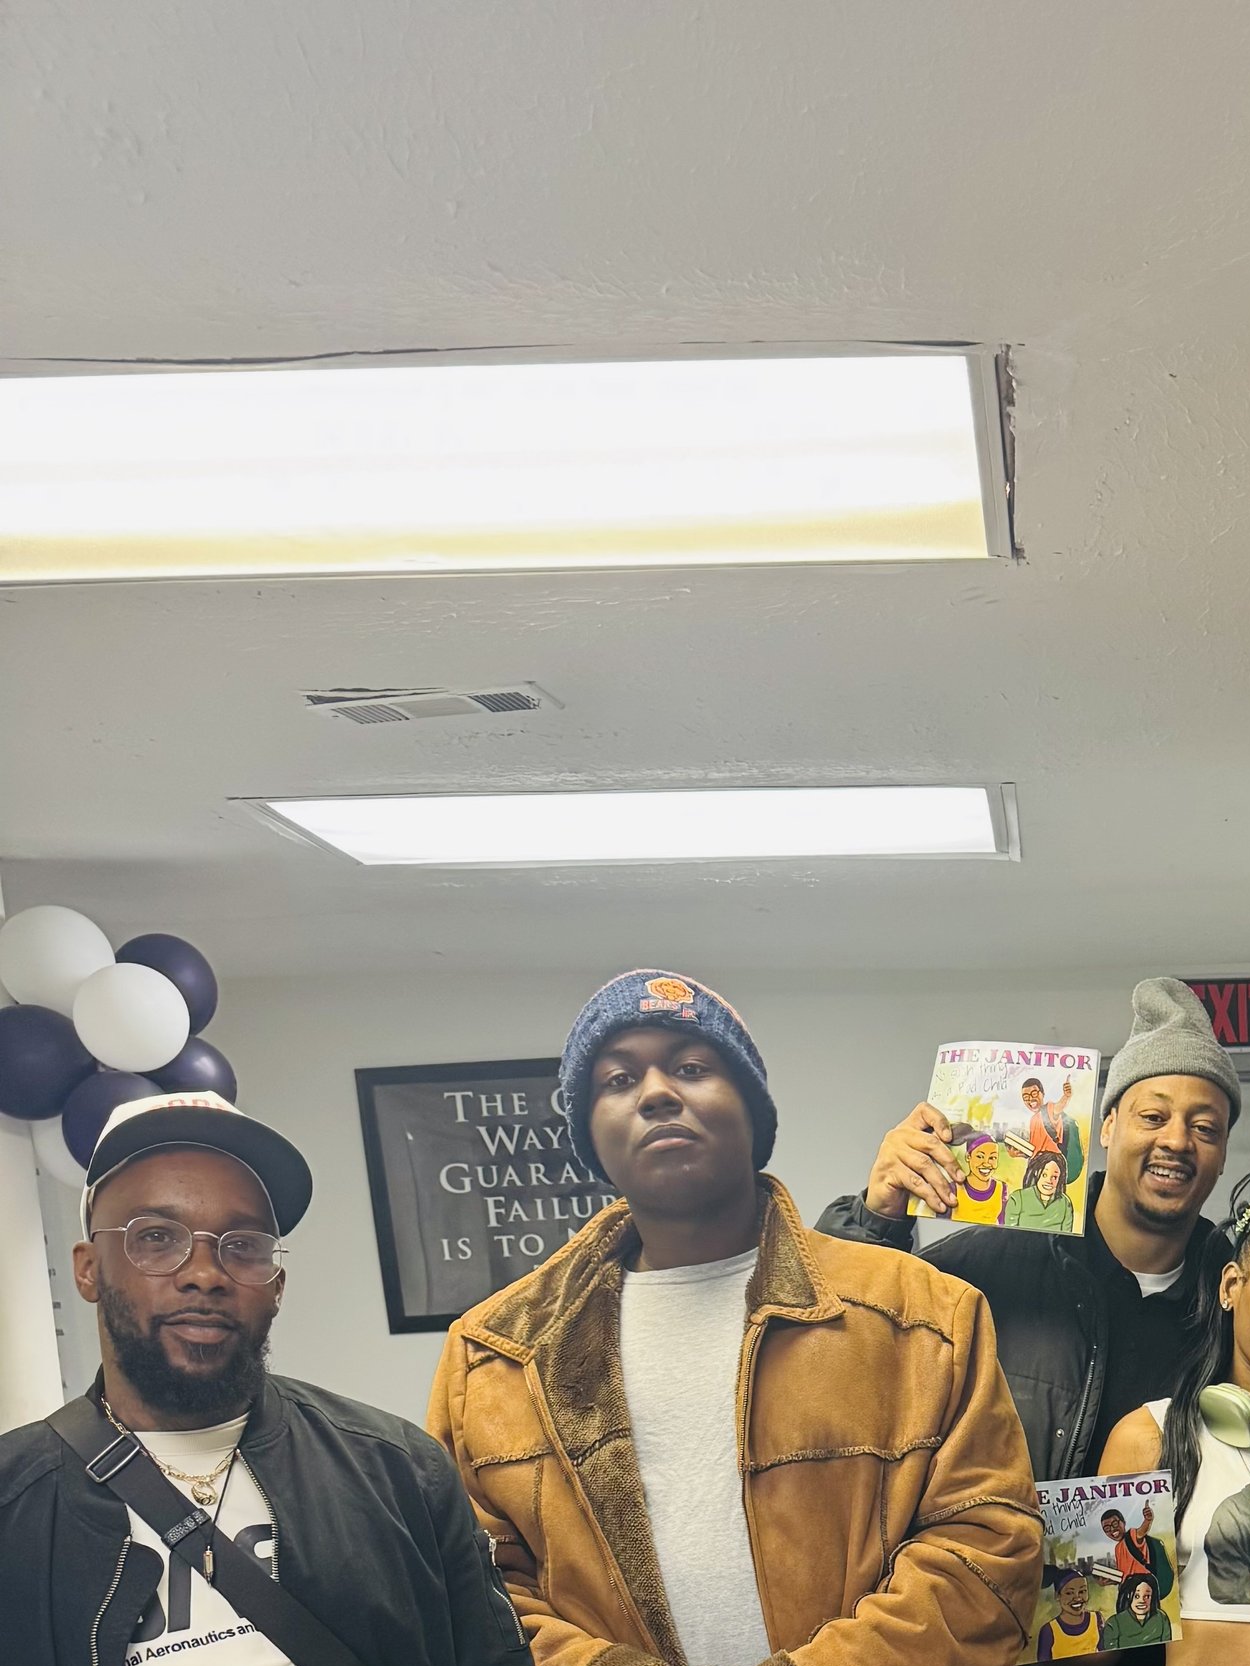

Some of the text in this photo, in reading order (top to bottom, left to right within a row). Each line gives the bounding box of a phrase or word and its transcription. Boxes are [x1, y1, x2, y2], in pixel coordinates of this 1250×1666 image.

[939, 1048, 1093, 1071] THE JANITOR
[444, 1091, 529, 1123] THE
[476, 1124, 565, 1157] WAY
[441, 1234, 545, 1261] IS TO
[1056, 1479, 1170, 1504] JANITOR
[1061, 1514, 1087, 1532] Child
[146, 1627, 236, 1661] Aeronautics
